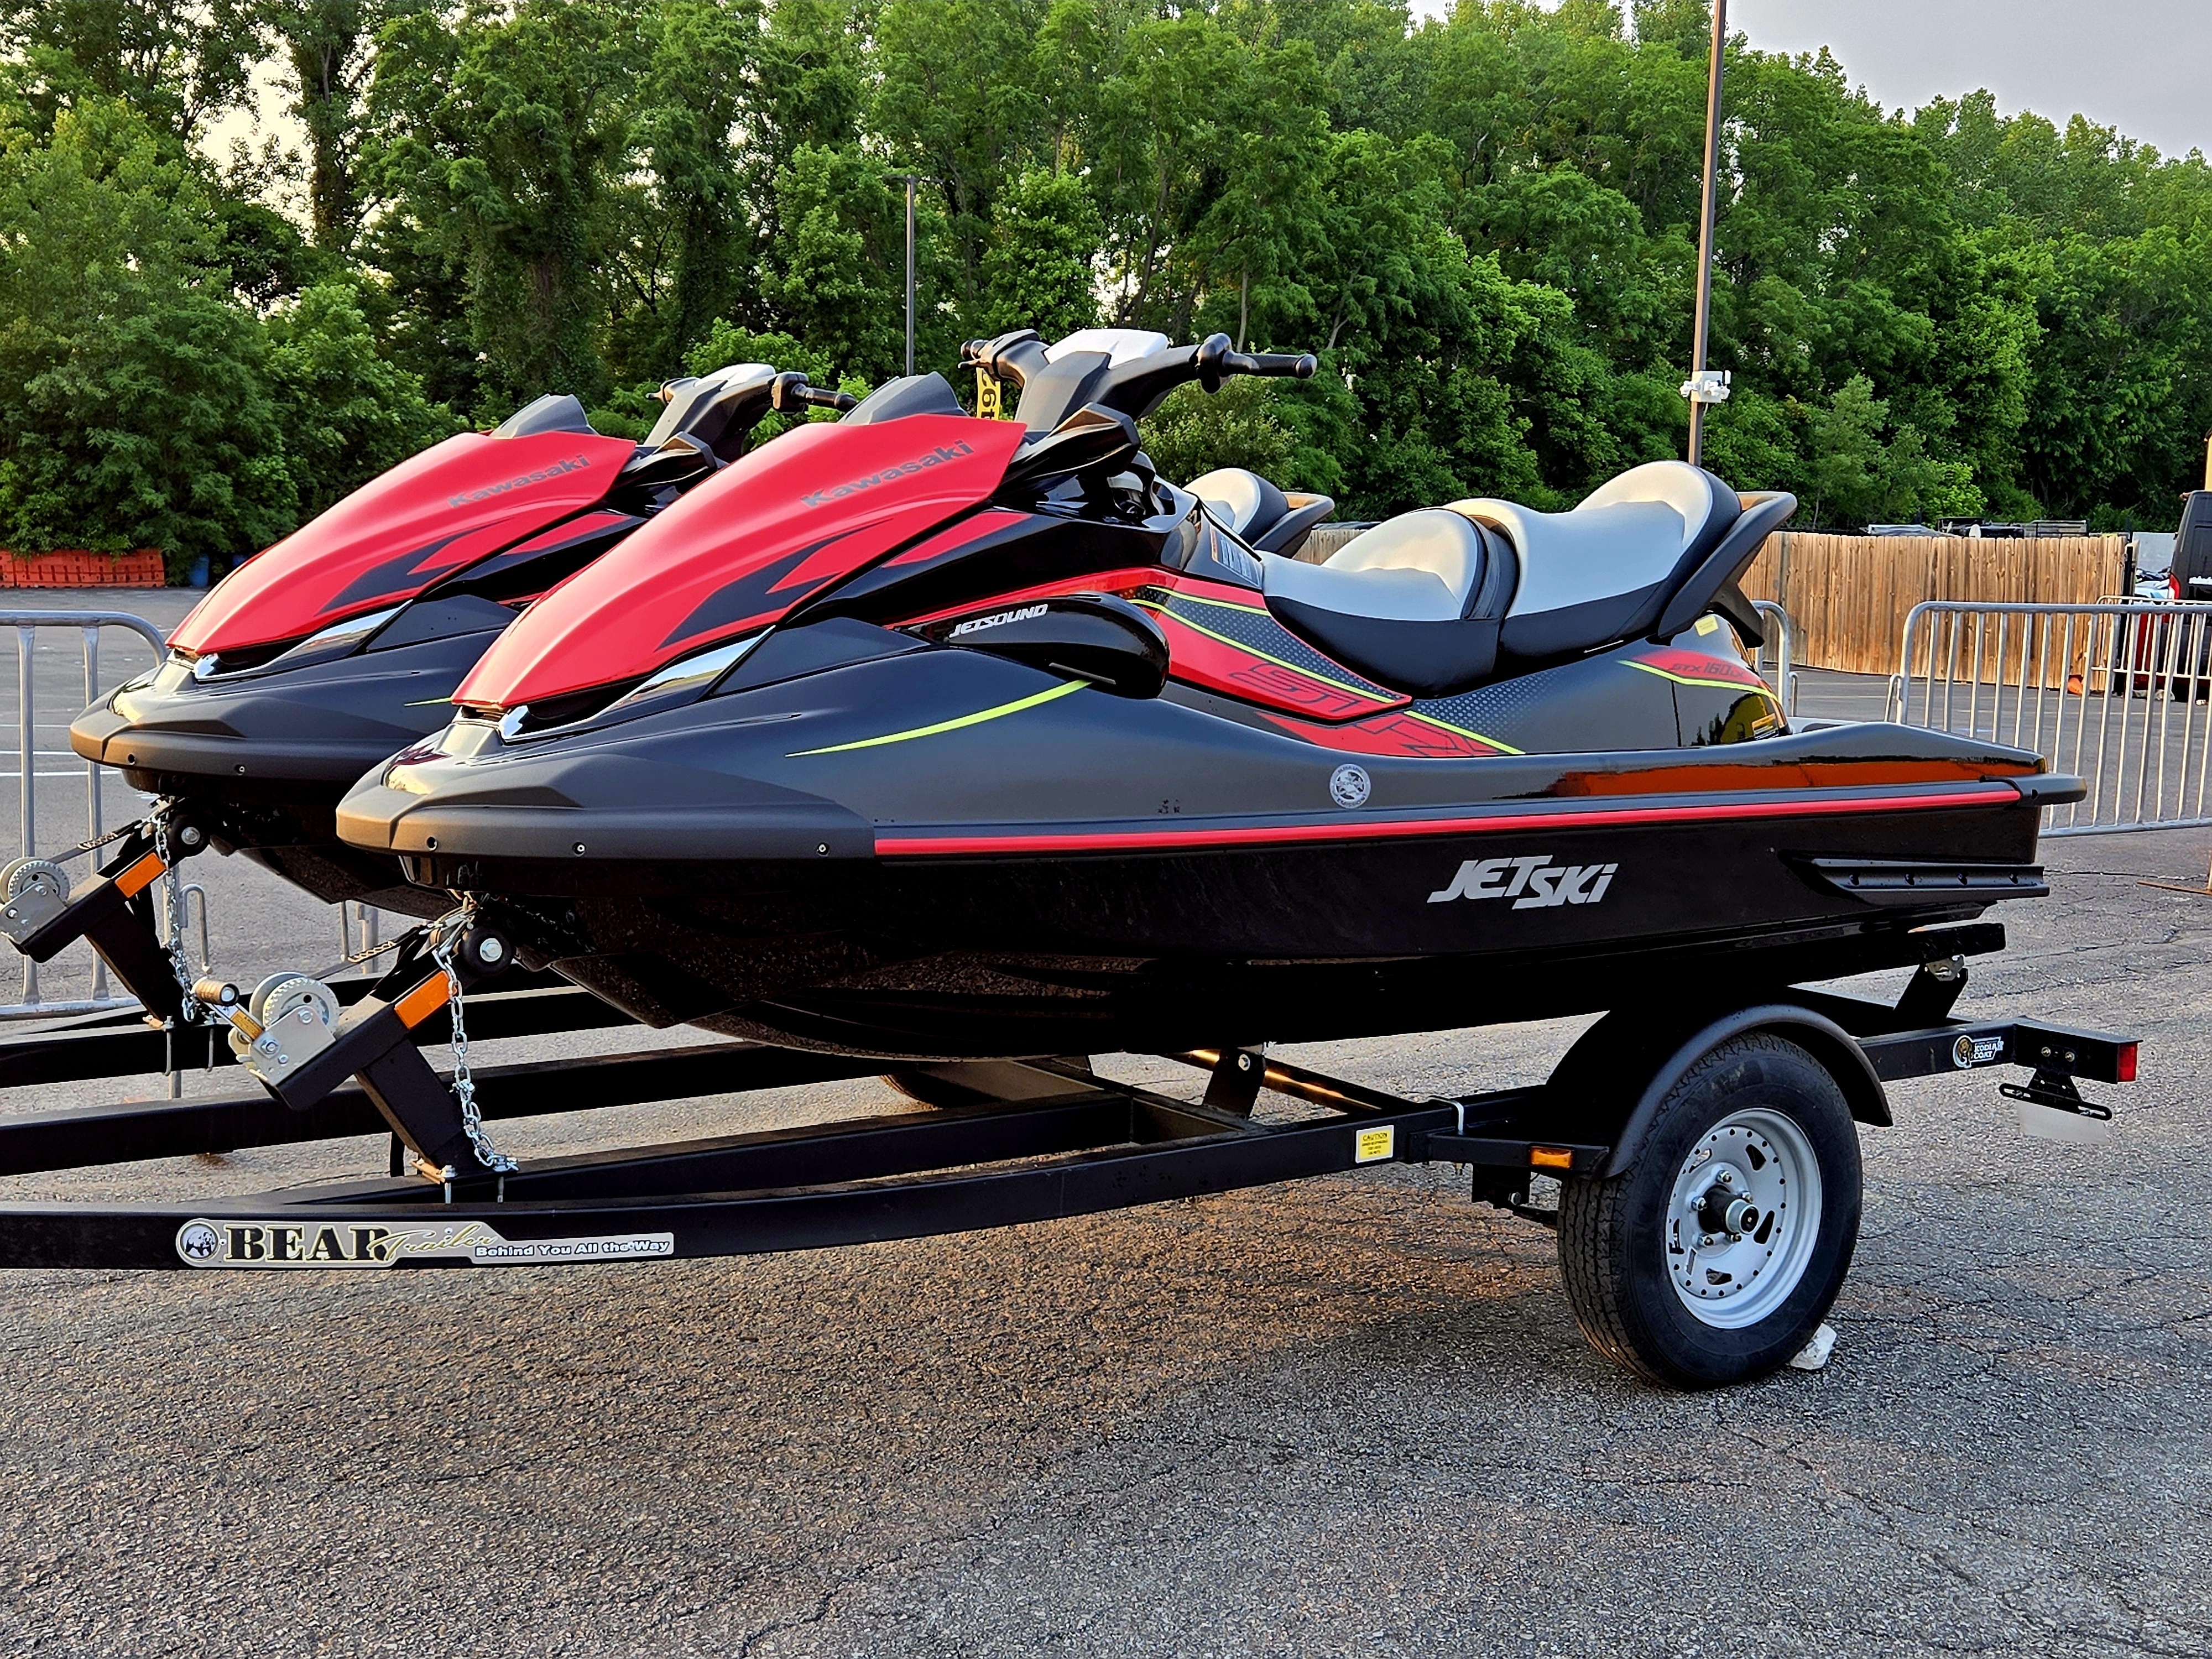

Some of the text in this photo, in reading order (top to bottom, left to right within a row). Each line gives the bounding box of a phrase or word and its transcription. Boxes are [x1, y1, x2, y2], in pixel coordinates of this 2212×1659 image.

[447, 455, 589, 508] Kawasaki
[800, 440, 974, 507] Kawasaki
[949, 604, 1048, 638] JETSOUND
[223, 1224, 393, 1263] BEAR
[474, 1239, 671, 1258] Behind You All the Way
